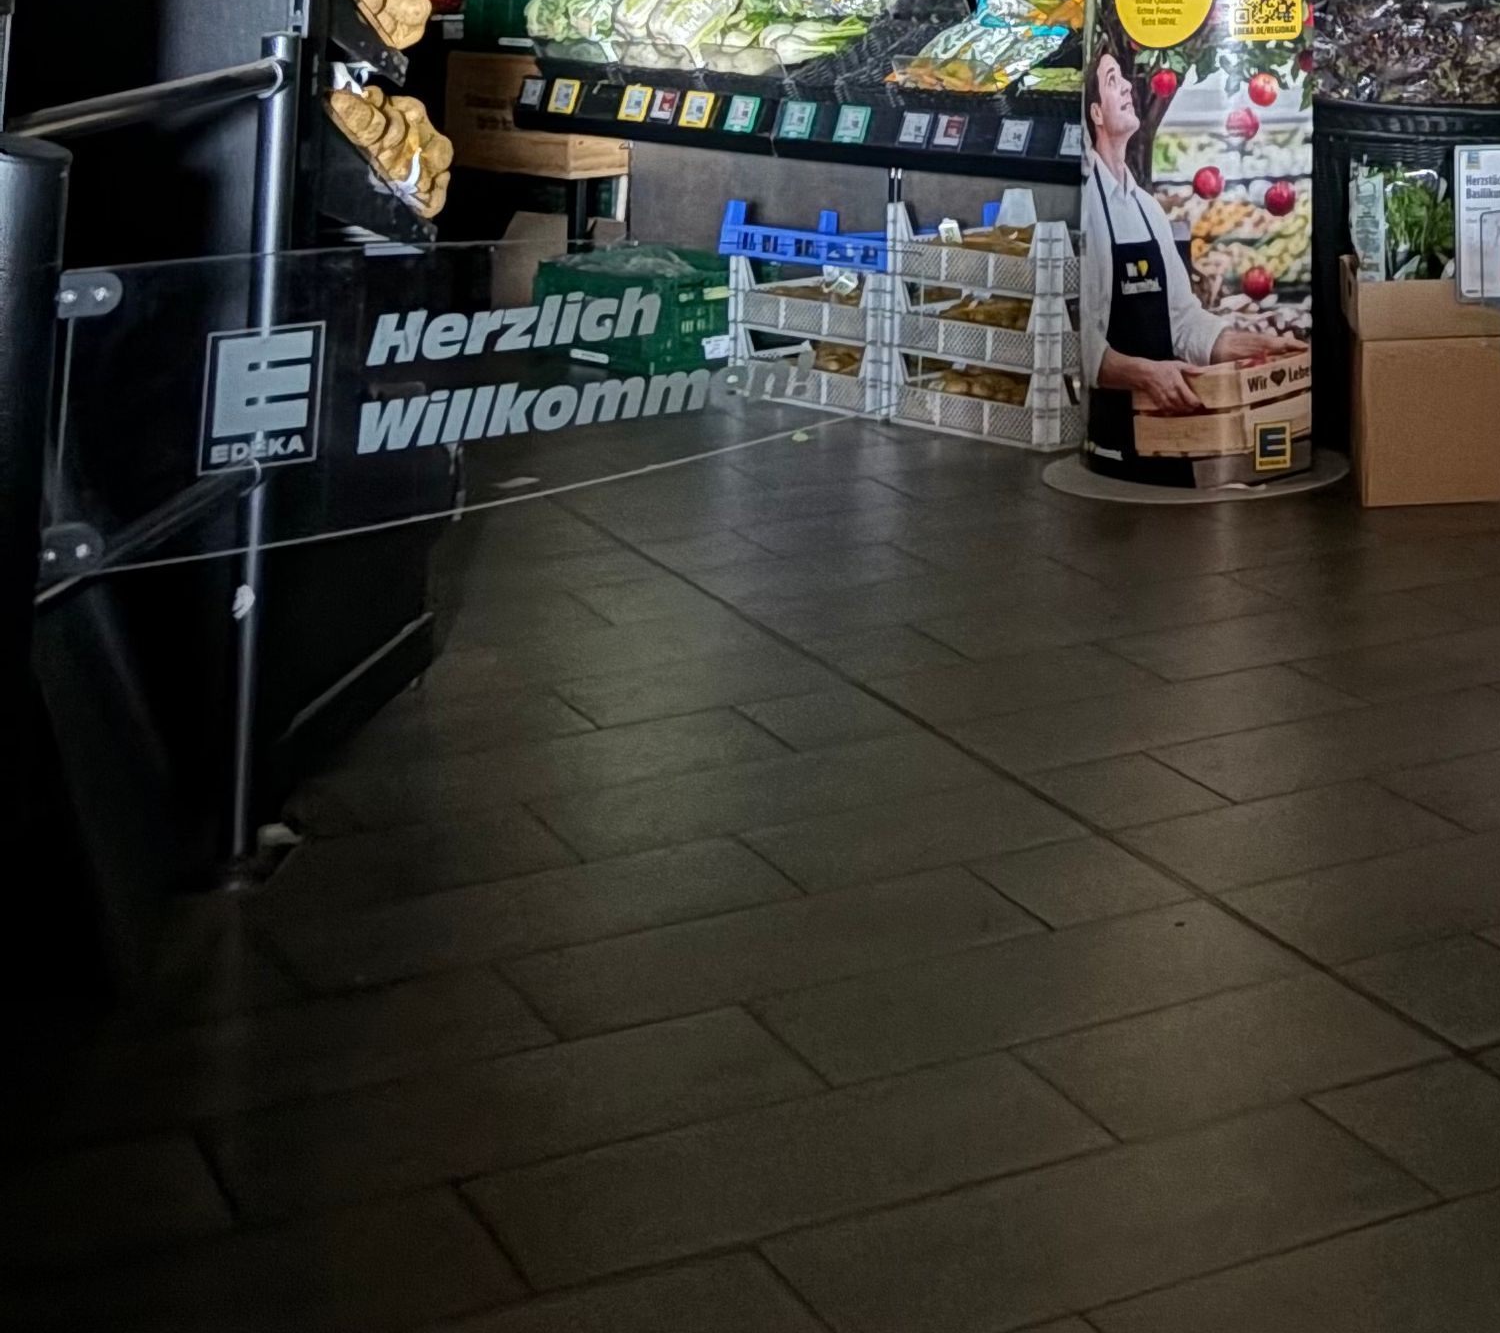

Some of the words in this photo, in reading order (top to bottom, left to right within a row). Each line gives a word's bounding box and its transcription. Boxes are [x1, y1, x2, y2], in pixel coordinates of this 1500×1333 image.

[365, 286, 664, 367] Herzlich
[356, 350, 817, 456] Willkommen!
[1247, 374, 1268, 393] Wir
[1288, 365, 1311, 384] Lebe
[209, 434, 305, 465] EDEKA
